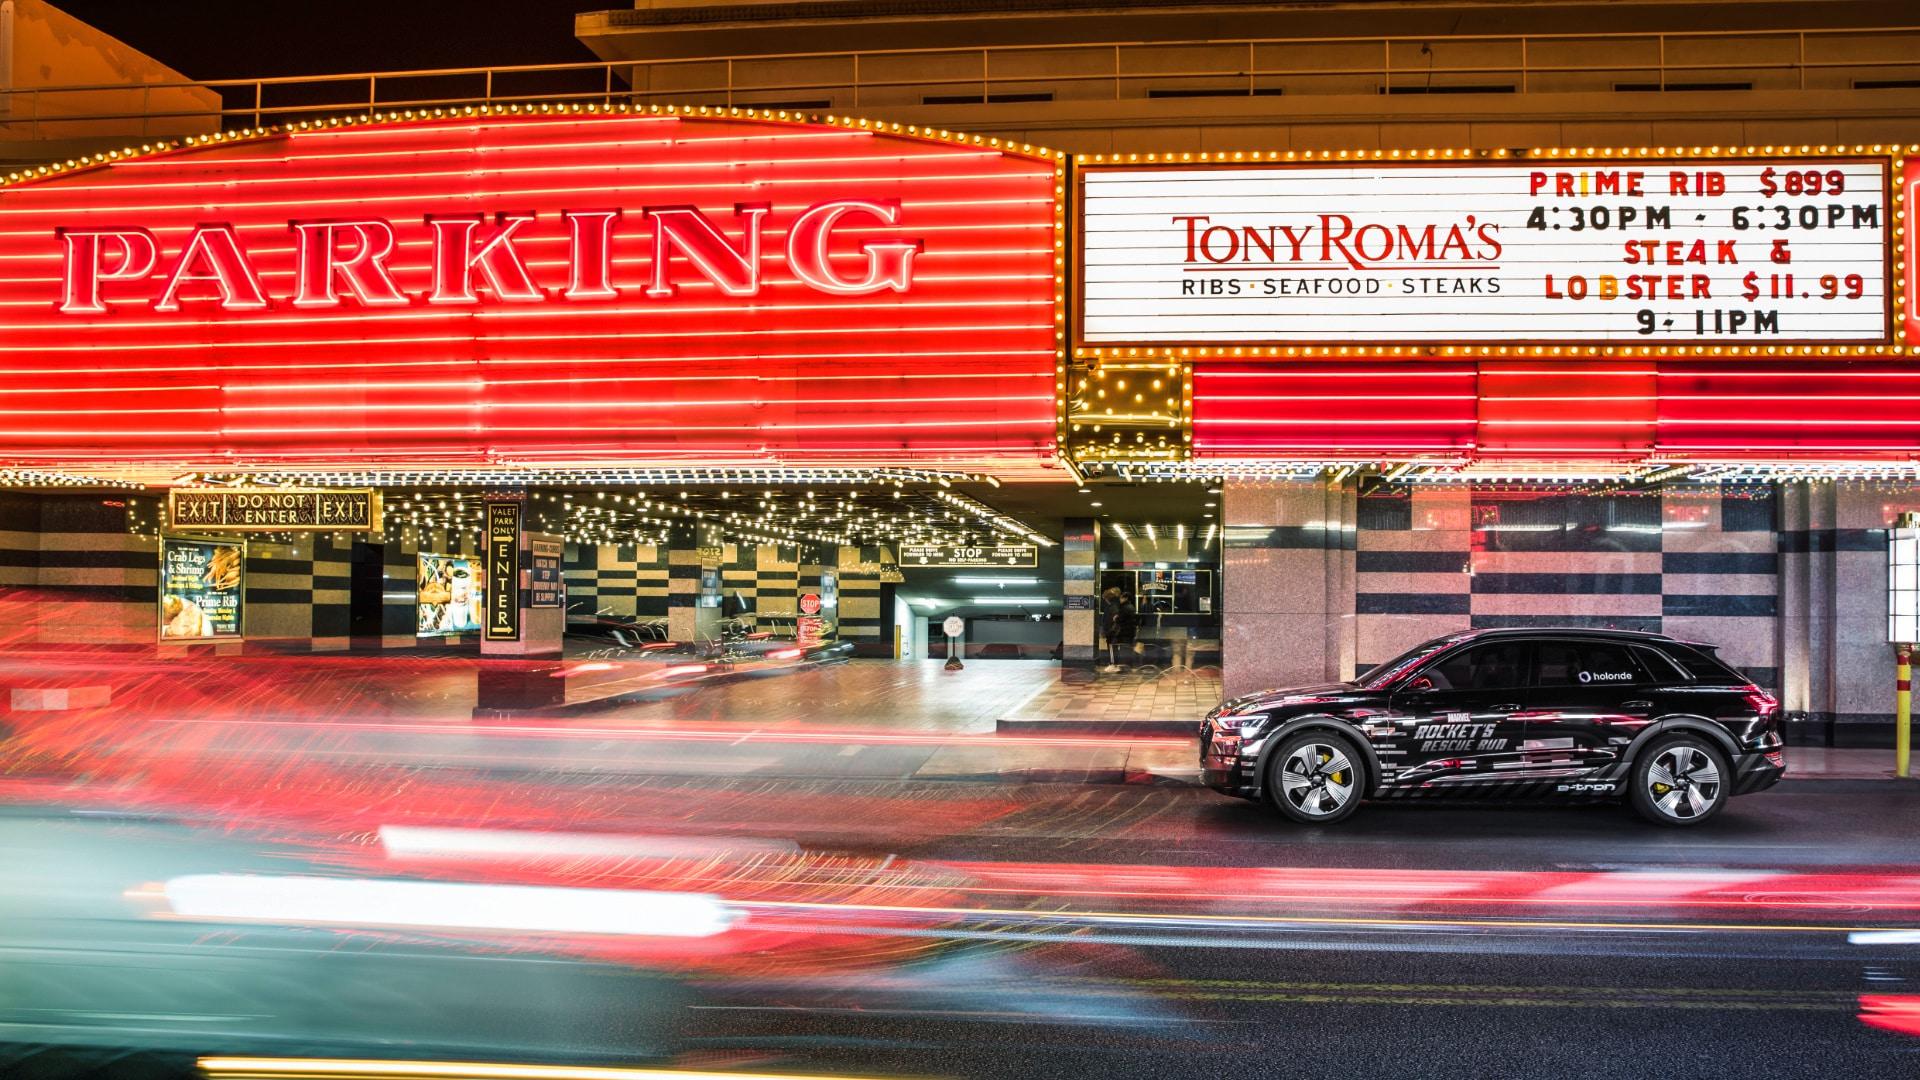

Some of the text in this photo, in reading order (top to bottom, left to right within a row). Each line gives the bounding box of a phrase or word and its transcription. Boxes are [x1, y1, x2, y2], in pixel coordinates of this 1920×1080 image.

[1530, 167, 1845, 198] PRIME RIB $899
[1526, 205, 1671, 231] 4:30PM
[1732, 203, 1879, 230] 6:30PM
[1172, 214, 1502, 271] TONY ROMA'S
[54, 199, 925, 316] PARKING
[1623, 238, 1792, 265] STEAK &
[1182, 277, 1501, 295] RIBS SEAFOOD STEAKS
[1545, 271, 1864, 301] LOBSTER $11.99
[238, 495, 305, 508] DO NOT
[177, 501, 220, 518] EXIT
[245, 510, 298, 523] ENTER
[324, 502, 366, 518] EXIT
[494, 517, 514, 525] PARK
[493, 527, 515, 535] ONLY
[168, 551, 206, 565] Crab Legs
[954, 548, 983, 558] STOP
[168, 563, 205, 576] & Shrimp
[497, 544, 510, 625] ENTER
[195, 595, 238, 607] Prime Rib
[1593, 671, 1632, 680] holoride
[1448, 713, 1471, 722] MARVEL
[1414, 724, 1497, 740] ROCKET'S
[1420, 738, 1509, 752] RESCUE RUN
[1557, 783, 1615, 792] e-tron
